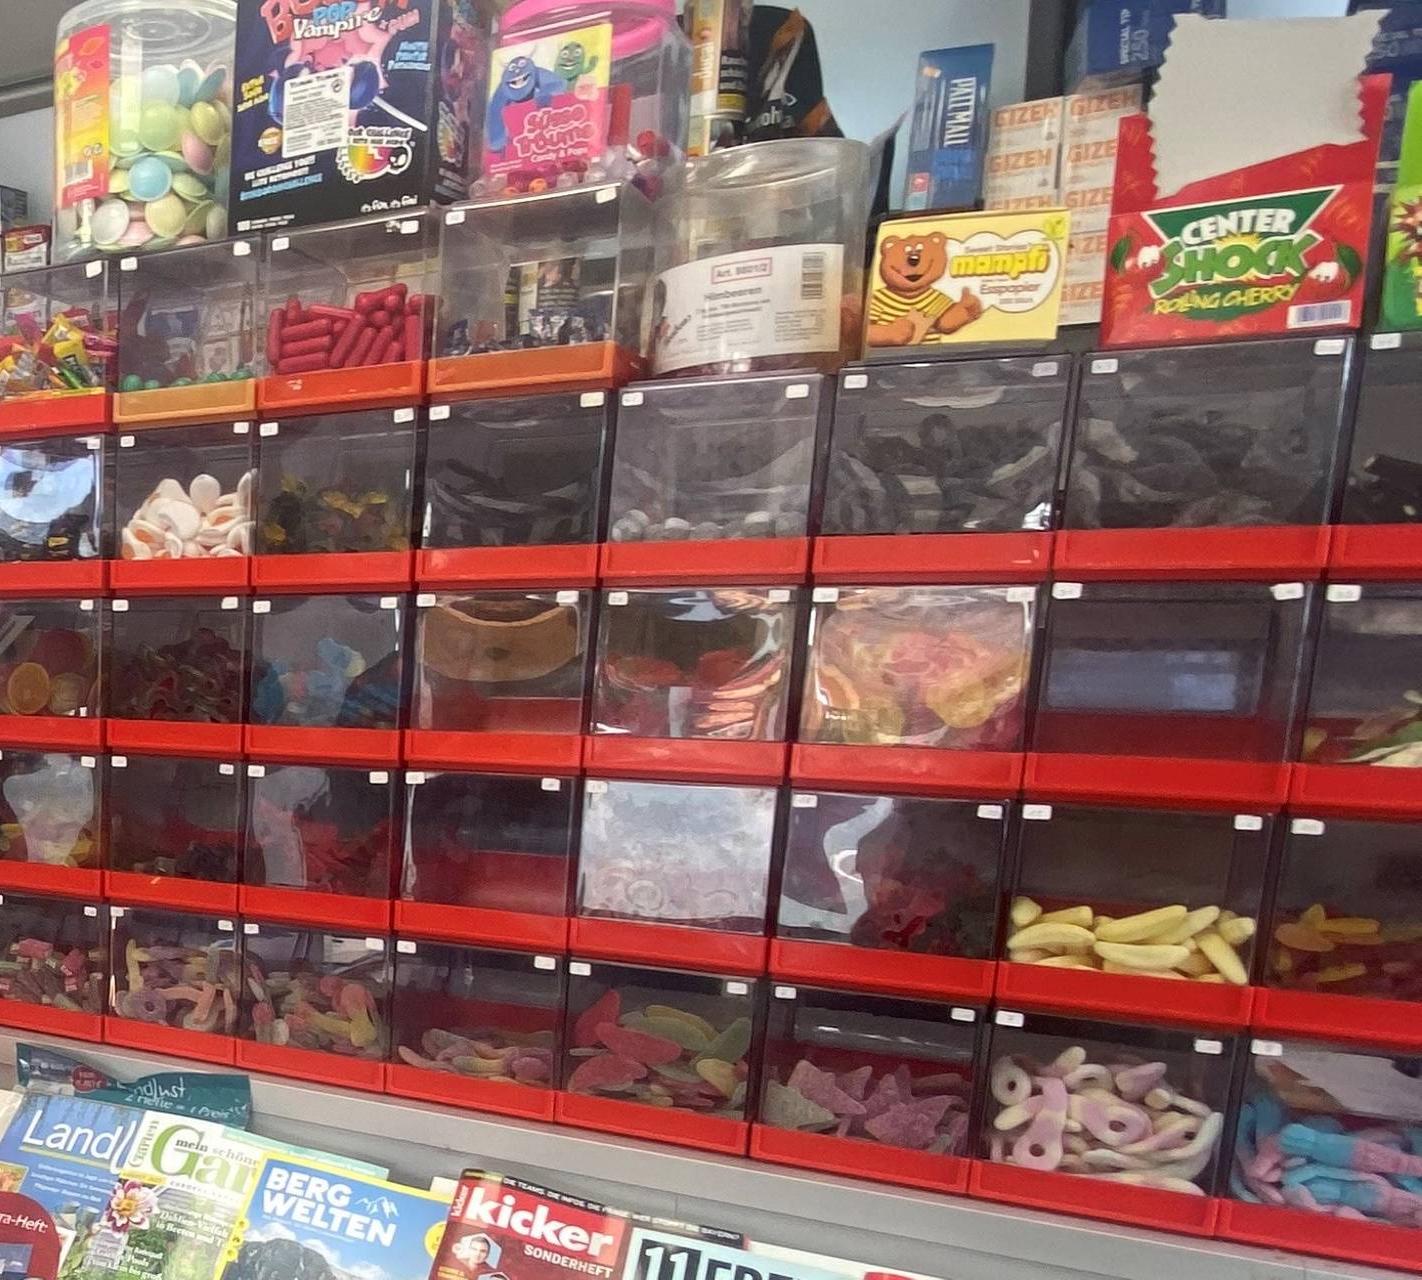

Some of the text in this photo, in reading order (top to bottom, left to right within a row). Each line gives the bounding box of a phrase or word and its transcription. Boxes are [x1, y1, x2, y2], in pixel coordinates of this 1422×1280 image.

[293, 6, 382, 40] Vampire
[995, 102, 1059, 128] GIZEH
[991, 149, 1053, 173] GIZEH
[1068, 139, 1118, 163] GIZE
[1065, 186, 1114, 209] GIZE
[1182, 208, 1296, 245] CENTER
[949, 244, 1050, 280] mampfi
[1148, 229, 1326, 299] SHOCK
[1222, 283, 1301, 308] CHERRY
[117, 1076, 186, 1099] Lndlust
[175, 1138, 209, 1153] mein
[265, 1166, 353, 1208] BERG
[262, 1189, 397, 1247] WELTEN
[465, 1186, 614, 1257] kicker
[523, 1243, 614, 1280] SONDERHEFT
[644, 1245, 693, 1280] 11
